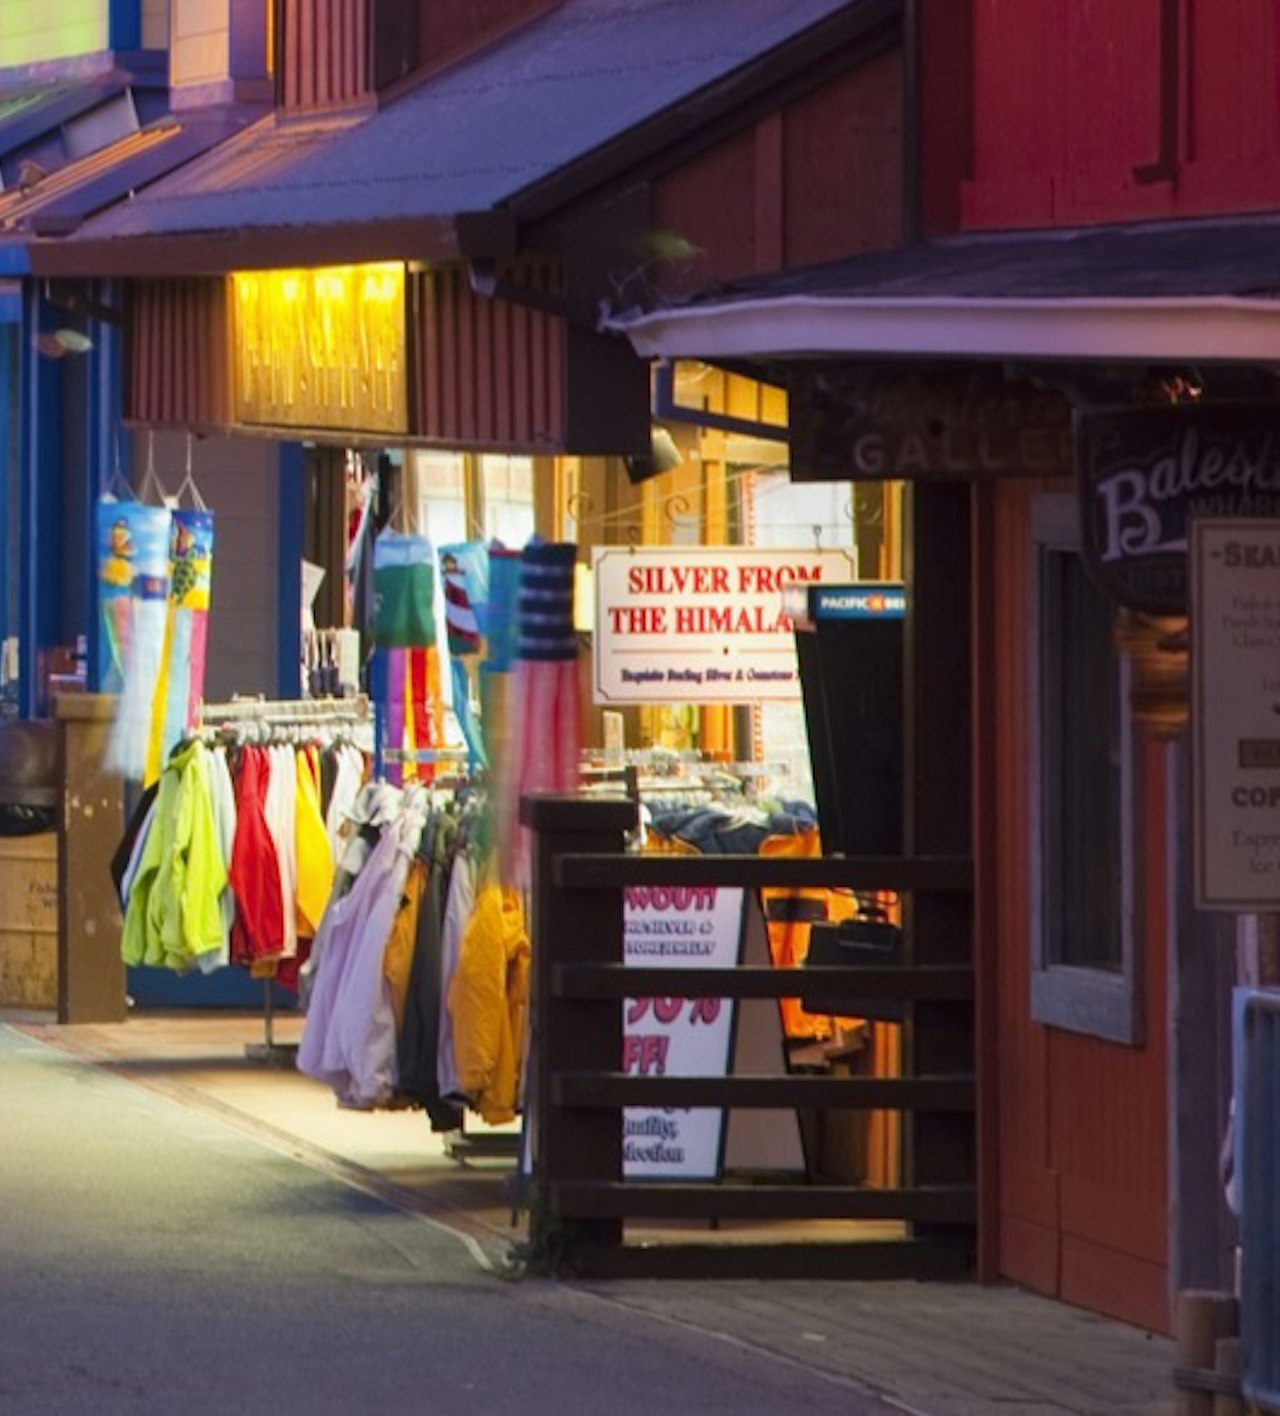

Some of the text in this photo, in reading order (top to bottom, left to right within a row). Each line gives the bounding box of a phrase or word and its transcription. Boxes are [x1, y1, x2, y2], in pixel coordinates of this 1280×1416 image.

[628, 566, 731, 595] SILVER
[820, 596, 867, 610] PACIFIC
[608, 606, 667, 634] THE
